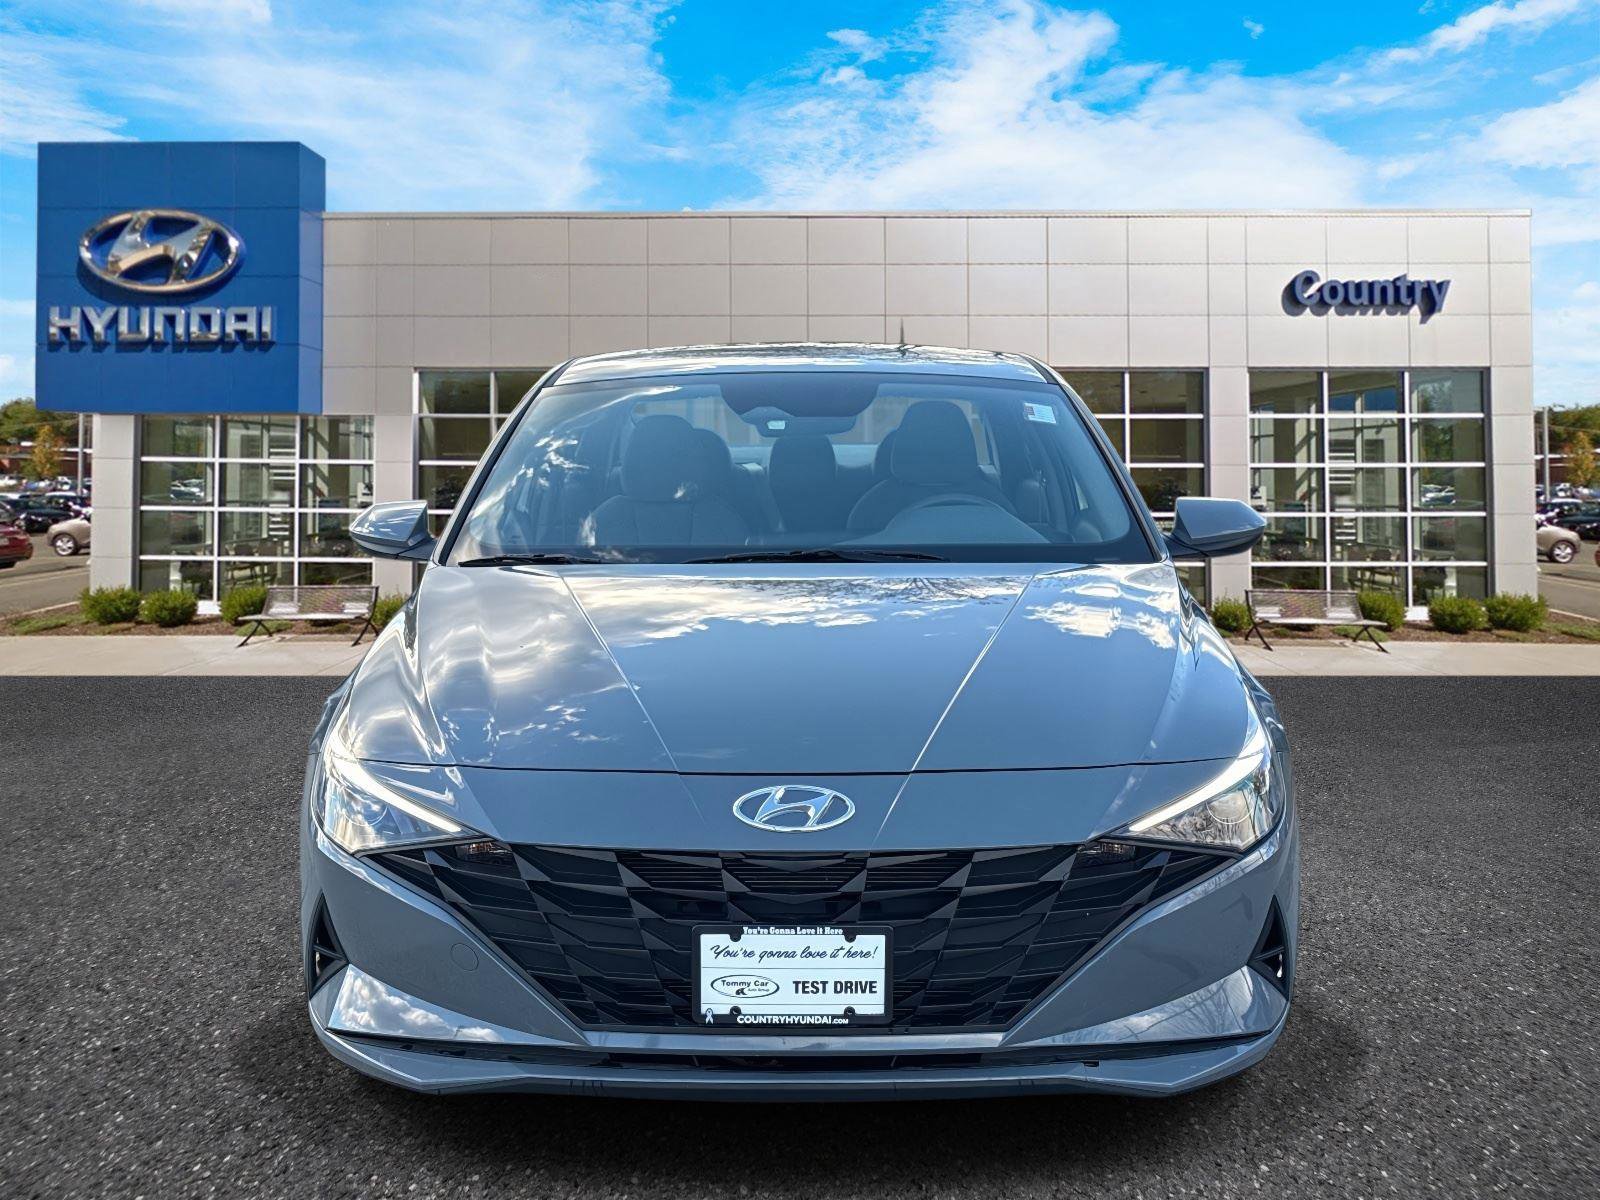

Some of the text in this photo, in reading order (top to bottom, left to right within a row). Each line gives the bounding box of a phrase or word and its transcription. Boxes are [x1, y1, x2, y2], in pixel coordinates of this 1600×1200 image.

[1281, 270, 1451, 325] Country
[48, 305, 276, 350] HYUNDAI
[743, 926, 768, 935] You're
[769, 926, 796, 935] Gonna
[797, 926, 816, 935] Love
[824, 926, 843, 935] Here
[710, 944, 755, 960] You're
[758, 949, 797, 963] gonna
[800, 945, 828, 959] love
[842, 945, 879, 960] here!
[721, 979, 769, 988] Tommy Car
[793, 980, 878, 995] TEST DRIVE
